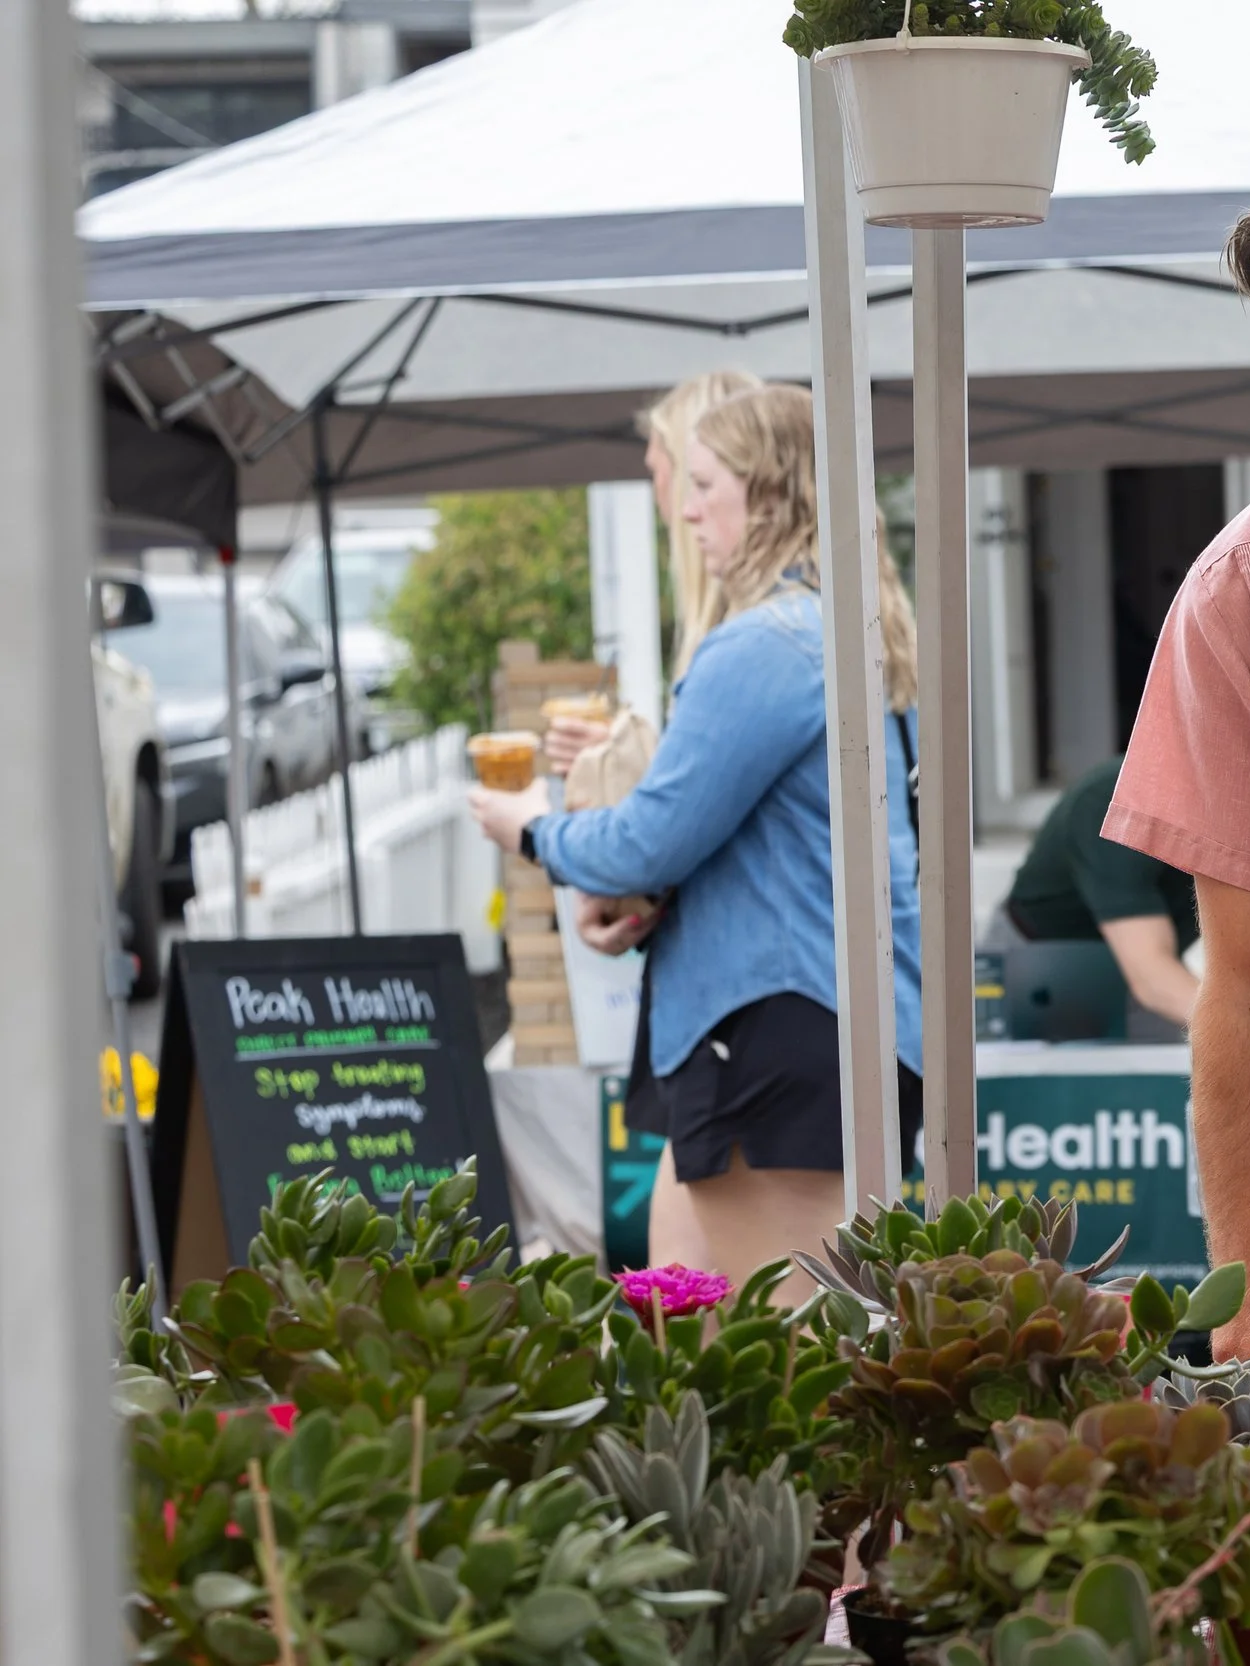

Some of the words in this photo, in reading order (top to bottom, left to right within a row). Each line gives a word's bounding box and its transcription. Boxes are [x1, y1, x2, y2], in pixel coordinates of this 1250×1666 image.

[225, 975, 315, 1029] Peak
[323, 975, 436, 1024] Health
[254, 1066, 320, 1100] Stop
[914, 1109, 1185, 1170] Health
[1048, 1178, 1135, 1205] CARE
